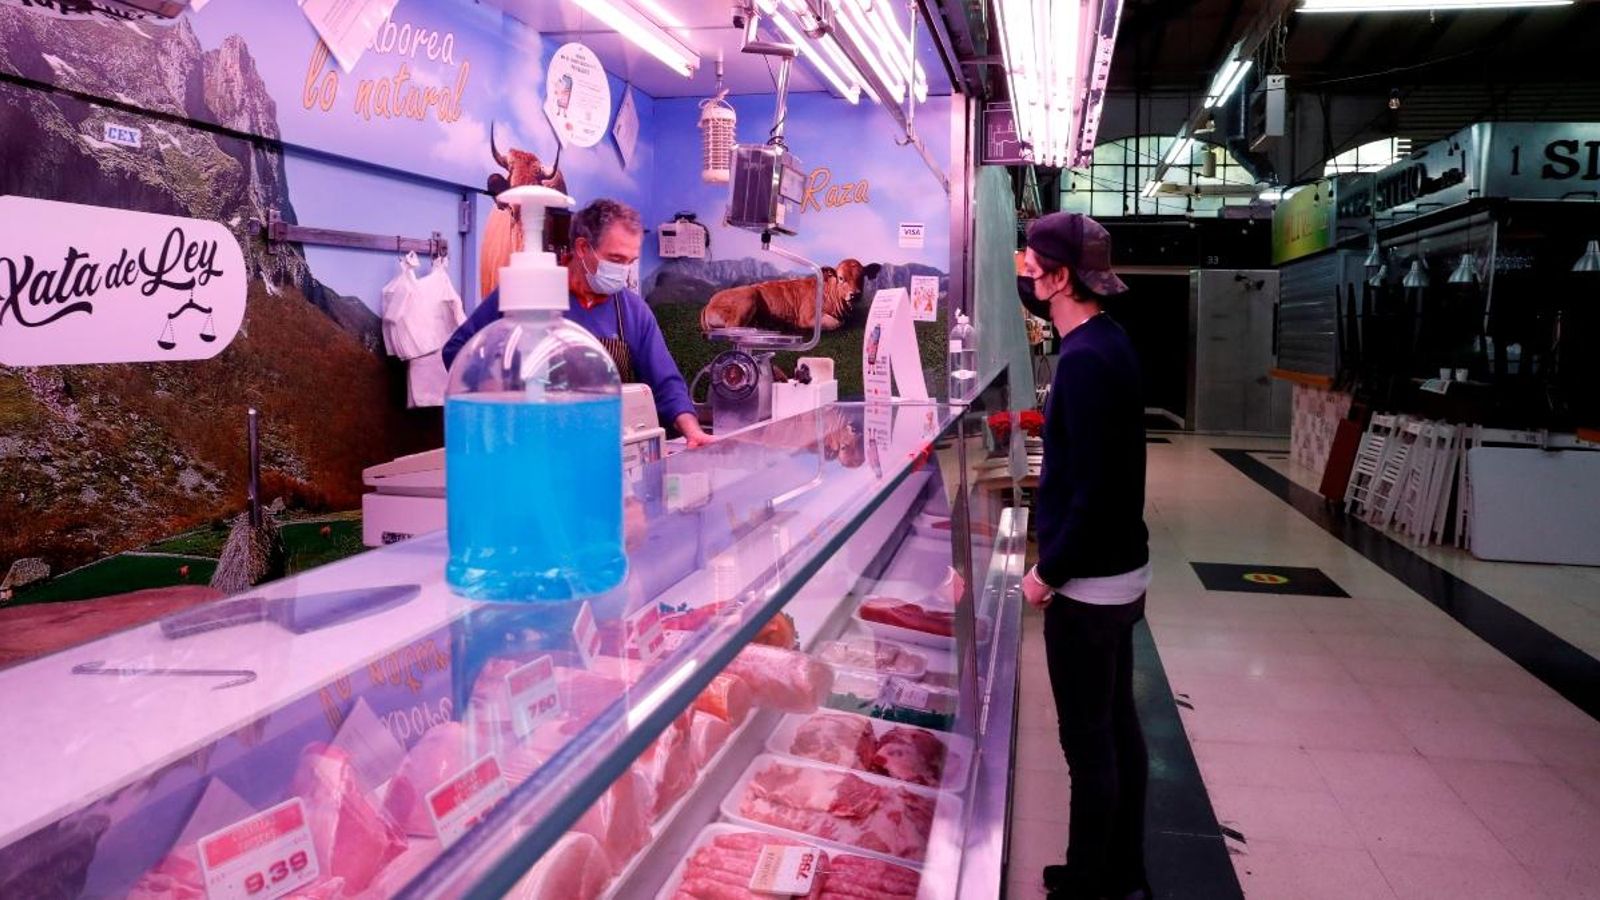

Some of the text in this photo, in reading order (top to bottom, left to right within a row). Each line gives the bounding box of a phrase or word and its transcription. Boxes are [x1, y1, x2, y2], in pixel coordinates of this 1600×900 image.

[108, 127, 138, 143] CEX
[800, 167, 870, 214] Raza
[105, 248, 140, 289] de
[139, 226, 224, 297] Ley
